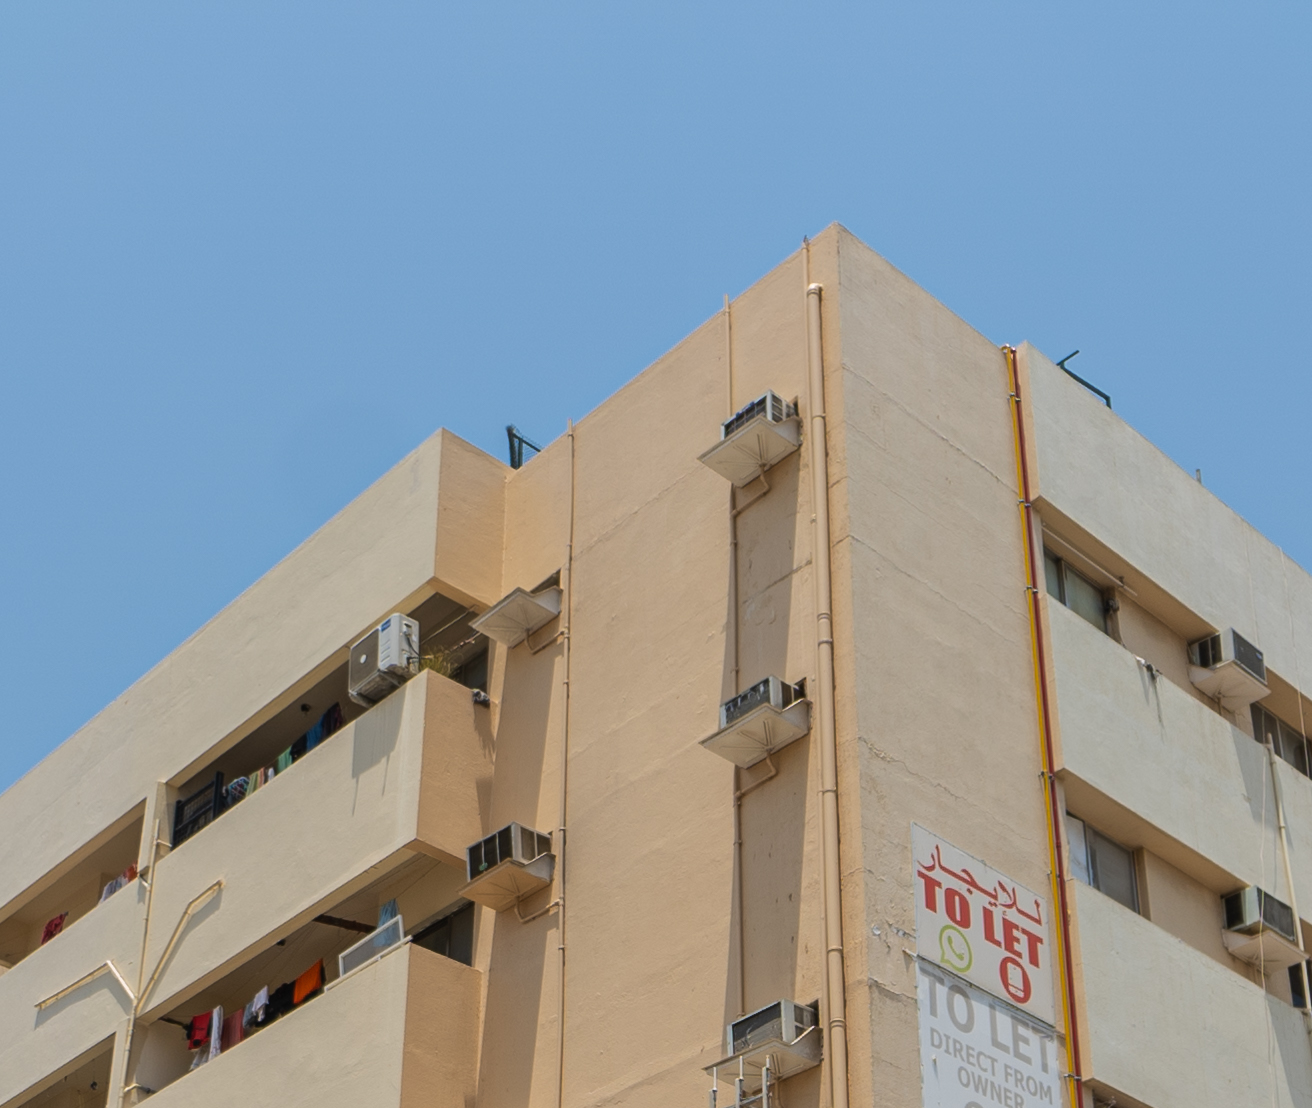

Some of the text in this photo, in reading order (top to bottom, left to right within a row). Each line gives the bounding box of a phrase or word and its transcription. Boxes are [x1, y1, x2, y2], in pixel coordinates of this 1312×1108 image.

[917, 870, 1044, 968] TO LET
[918, 964, 1057, 1074] TO LET
[929, 1026, 1053, 1105] DIRECT FROM
